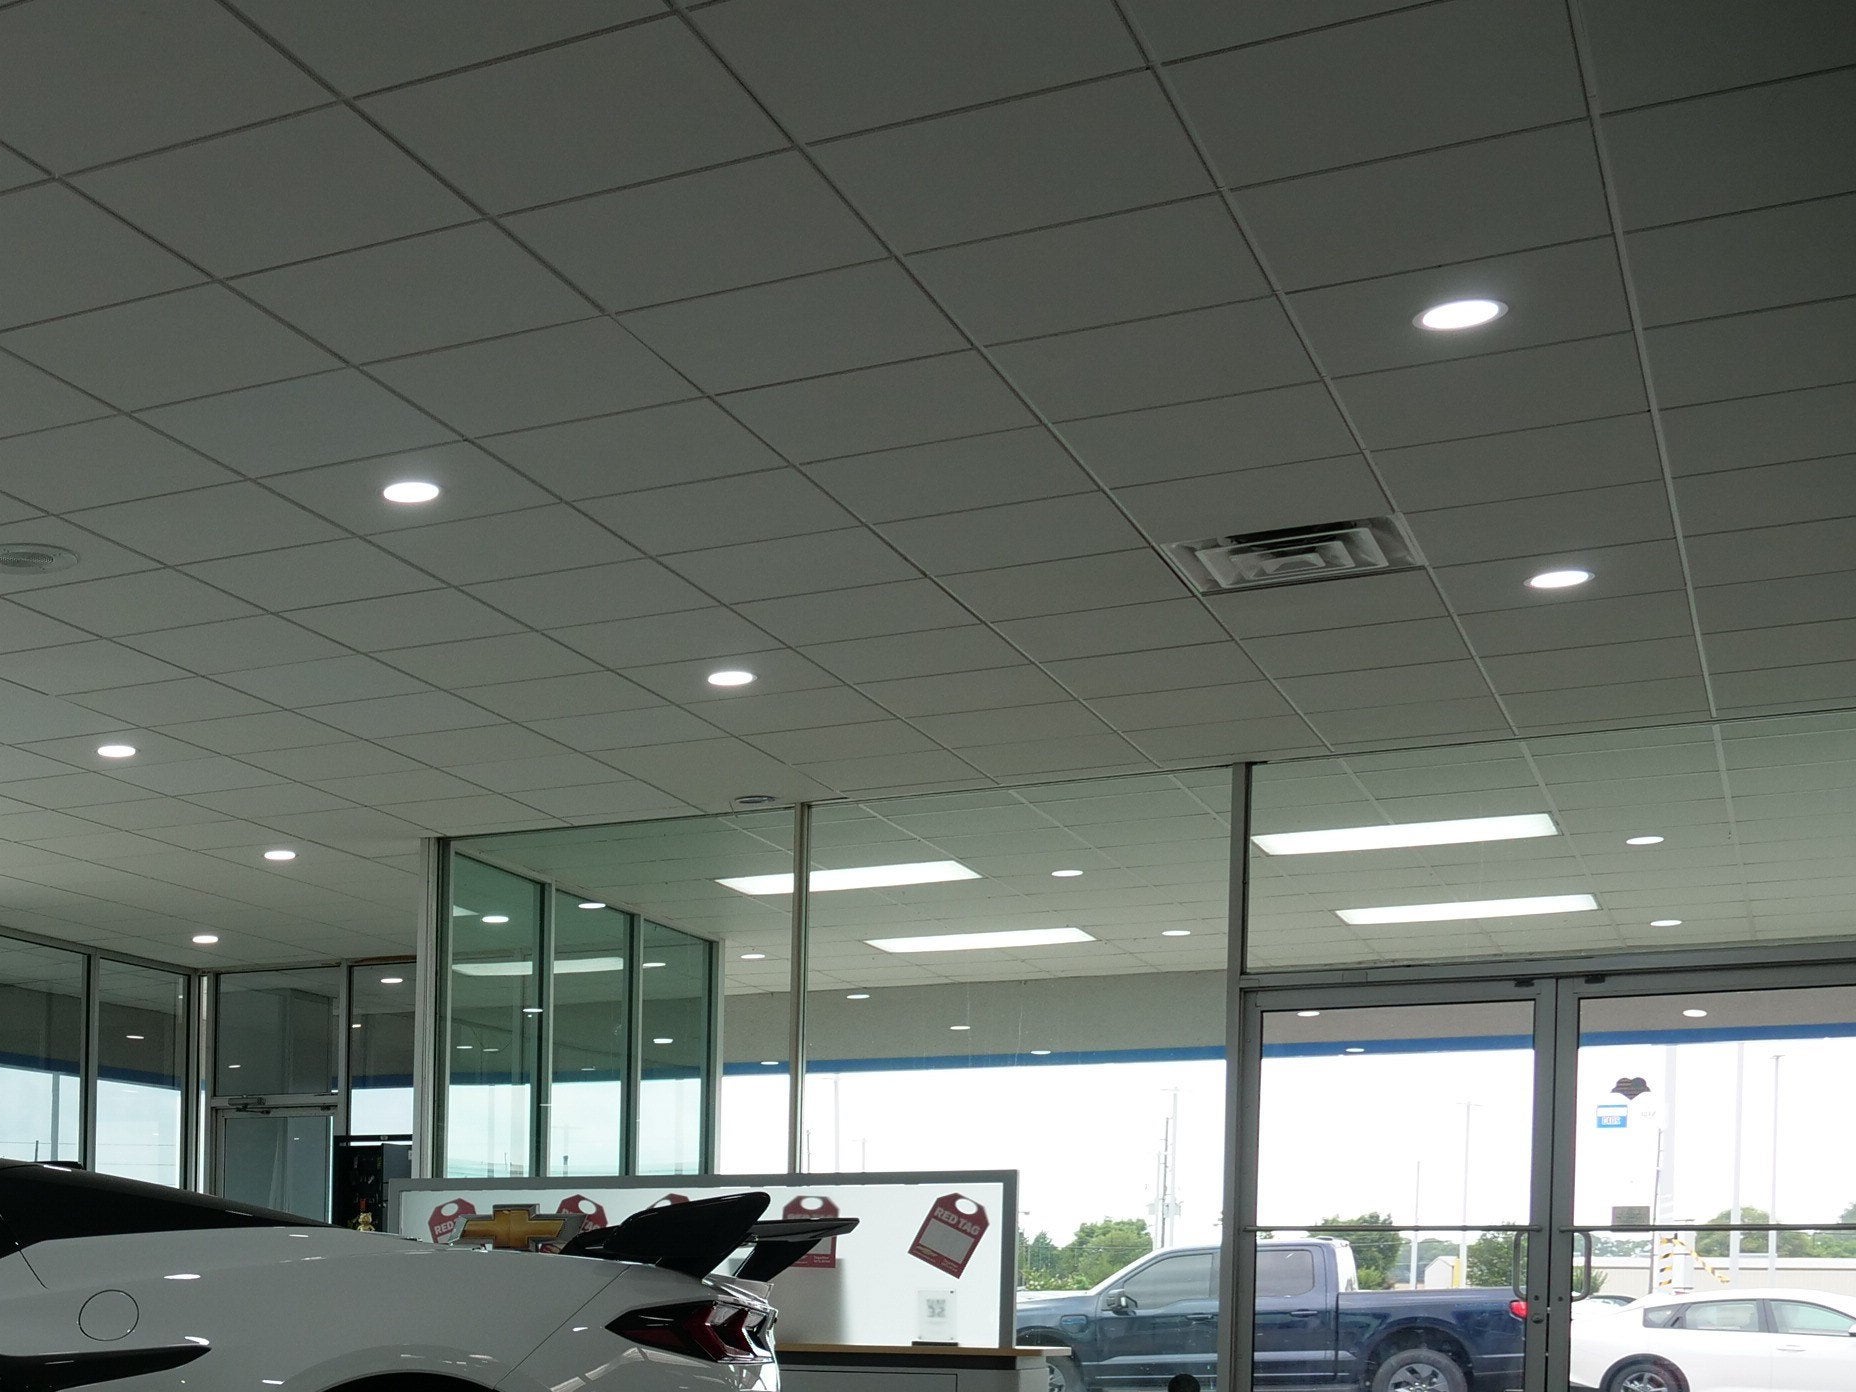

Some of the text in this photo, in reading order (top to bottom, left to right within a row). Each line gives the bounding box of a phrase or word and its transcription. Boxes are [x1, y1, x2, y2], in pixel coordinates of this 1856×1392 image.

[434, 1220, 454, 1235] RED
[934, 1206, 981, 1236] RED TAG
